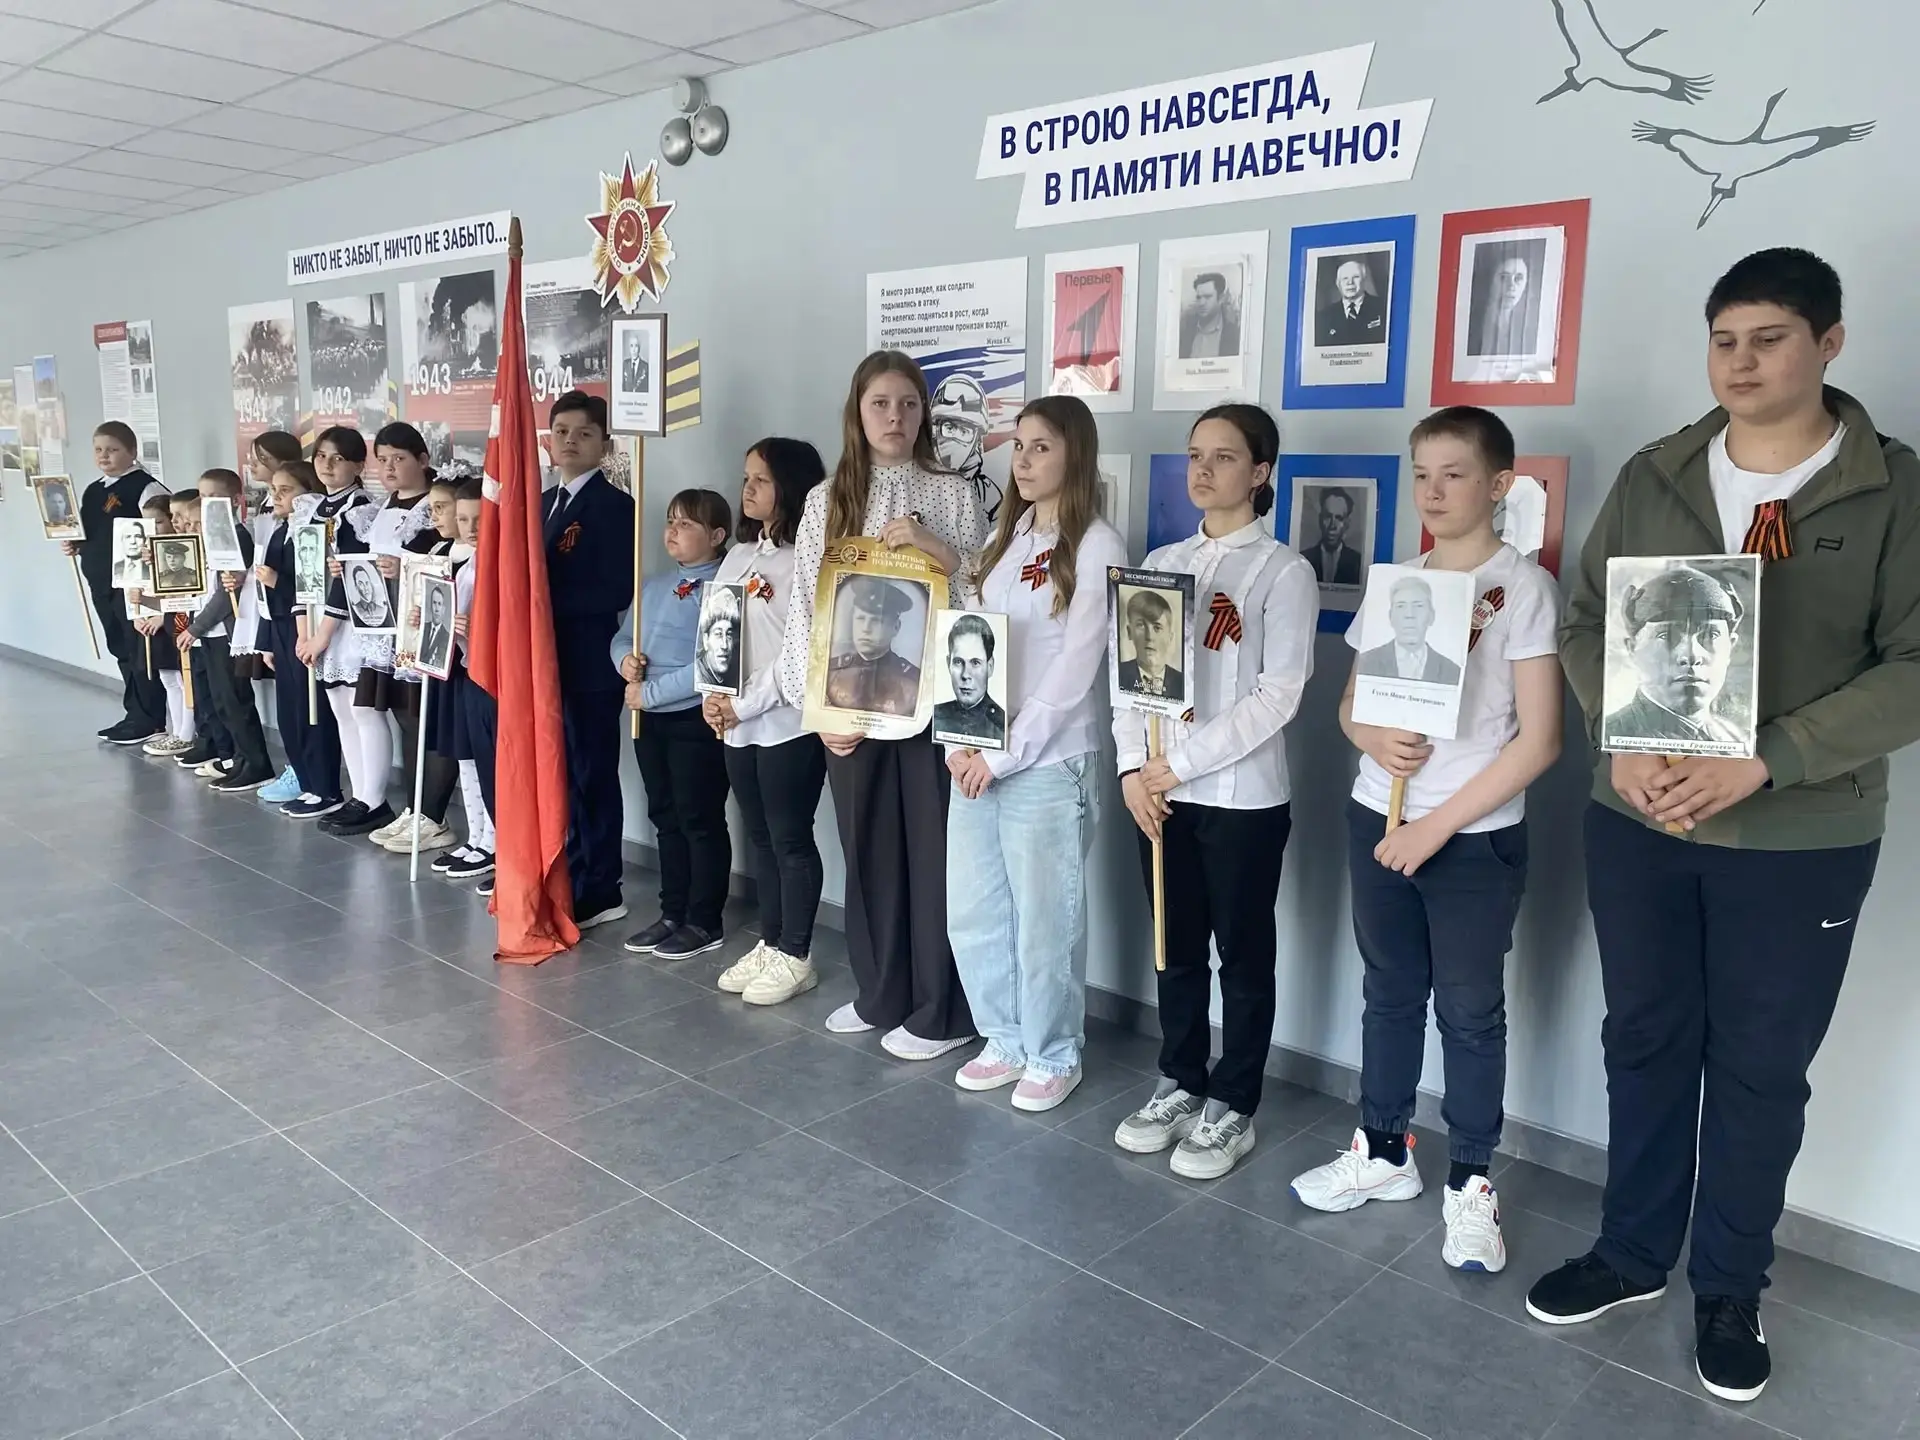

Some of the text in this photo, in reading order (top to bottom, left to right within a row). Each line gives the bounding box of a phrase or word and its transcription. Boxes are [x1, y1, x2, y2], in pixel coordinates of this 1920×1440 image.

[1000, 69, 1330, 159] В СТРОЮ НАВСЕГДА,
[1045, 119, 1401, 206] В ПАМЯТИ НАВЕЧНО!
[293, 251, 327, 275] НИКТО
[329, 249, 343, 269] НЕ
[344, 241, 382, 267] ЗАБЫТ,
[384, 235, 422, 261] НИЧТО
[425, 231, 440, 254] НЕ
[881, 288, 885, 297] Я
[886, 289, 903, 297] много
[904, 287, 914, 297] раз
[936, 284, 947, 292] как
[948, 282, 975, 292] солдаты
[1065, 272, 1112, 290] Первые
[881, 314, 891, 323] Это
[918, 311, 949, 321] подняться
[972, 308, 989, 317] когда
[410, 363, 451, 396] 1943
[240, 397, 268, 423] 1941
[319, 386, 352, 415] 1942
[870, 550, 926, 565] БЕССМЕРТНЫЙ
[872, 558, 894, 568] ПОЛК
